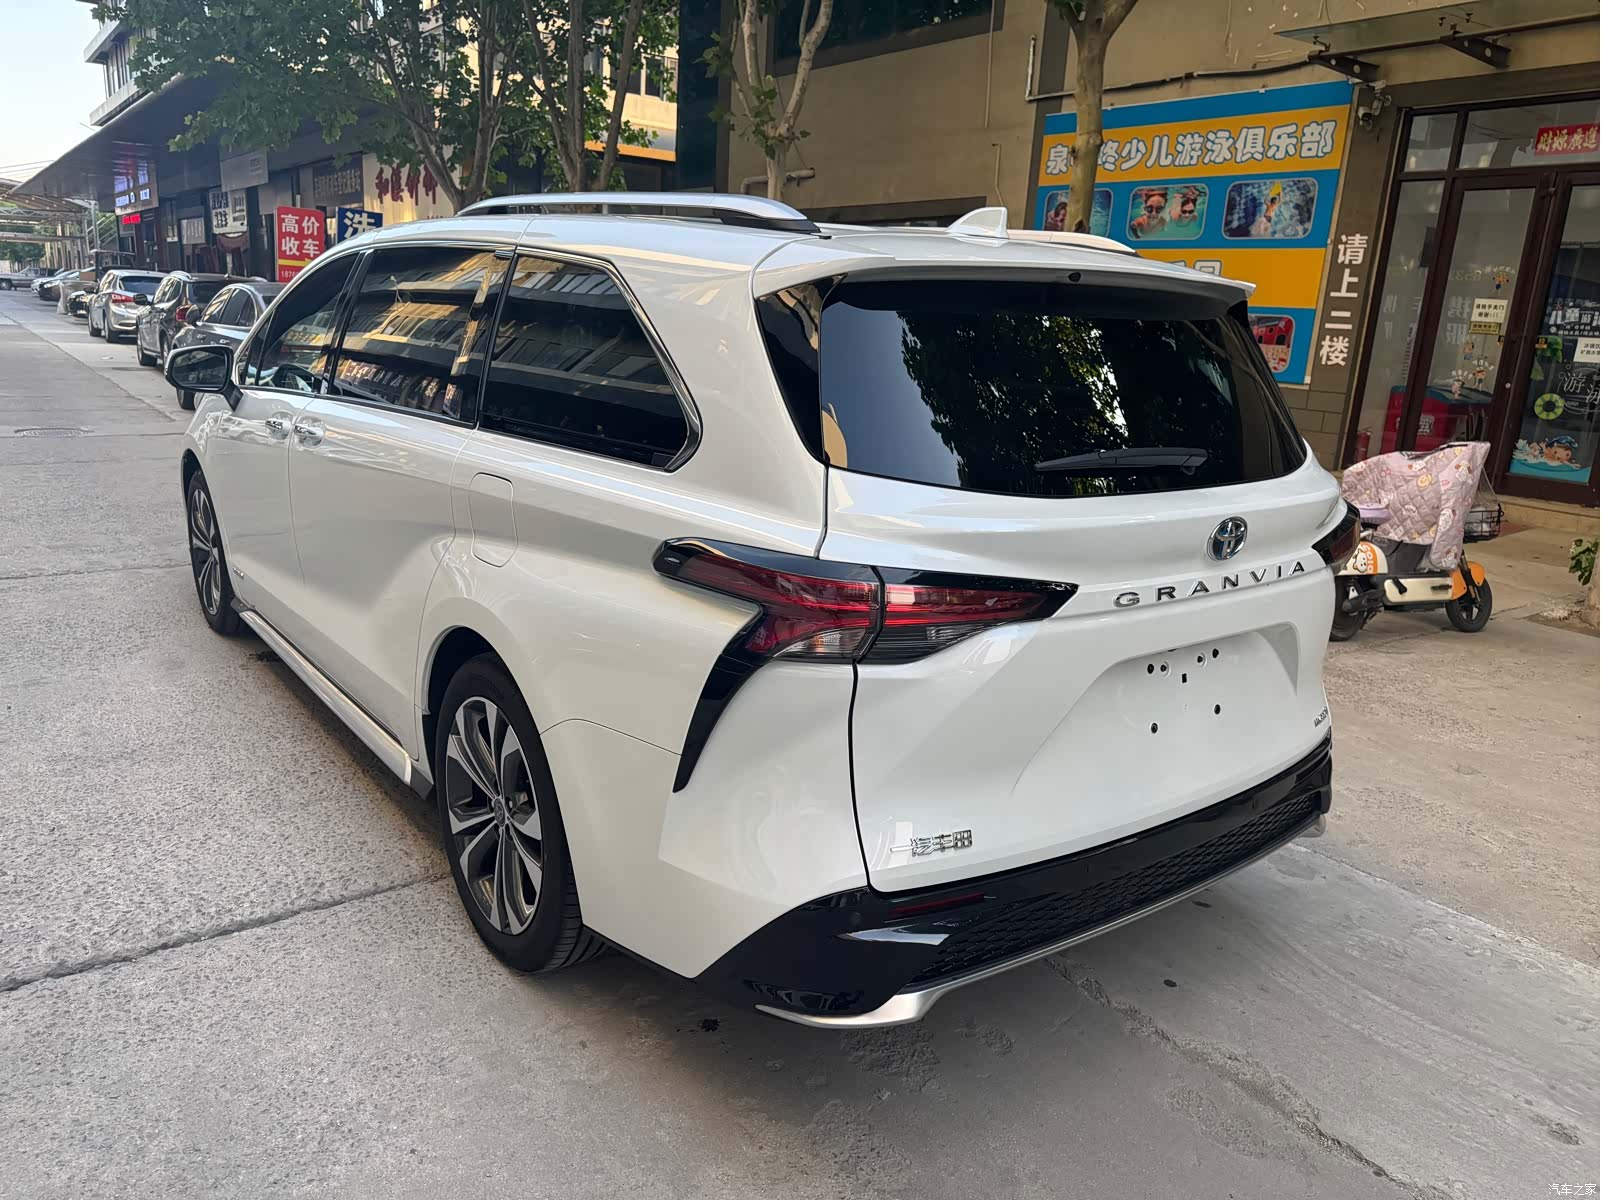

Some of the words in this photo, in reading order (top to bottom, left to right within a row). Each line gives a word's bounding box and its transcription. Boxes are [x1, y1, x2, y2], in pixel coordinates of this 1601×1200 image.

[1046, 120, 1337, 175] 泉咚少儿游泳俱乐部
[281, 214, 320, 236] 高价
[281, 236, 320, 257] 收车
[1320, 234, 1368, 367] 请上二楼
[1113, 561, 1305, 607] GRANVIA
